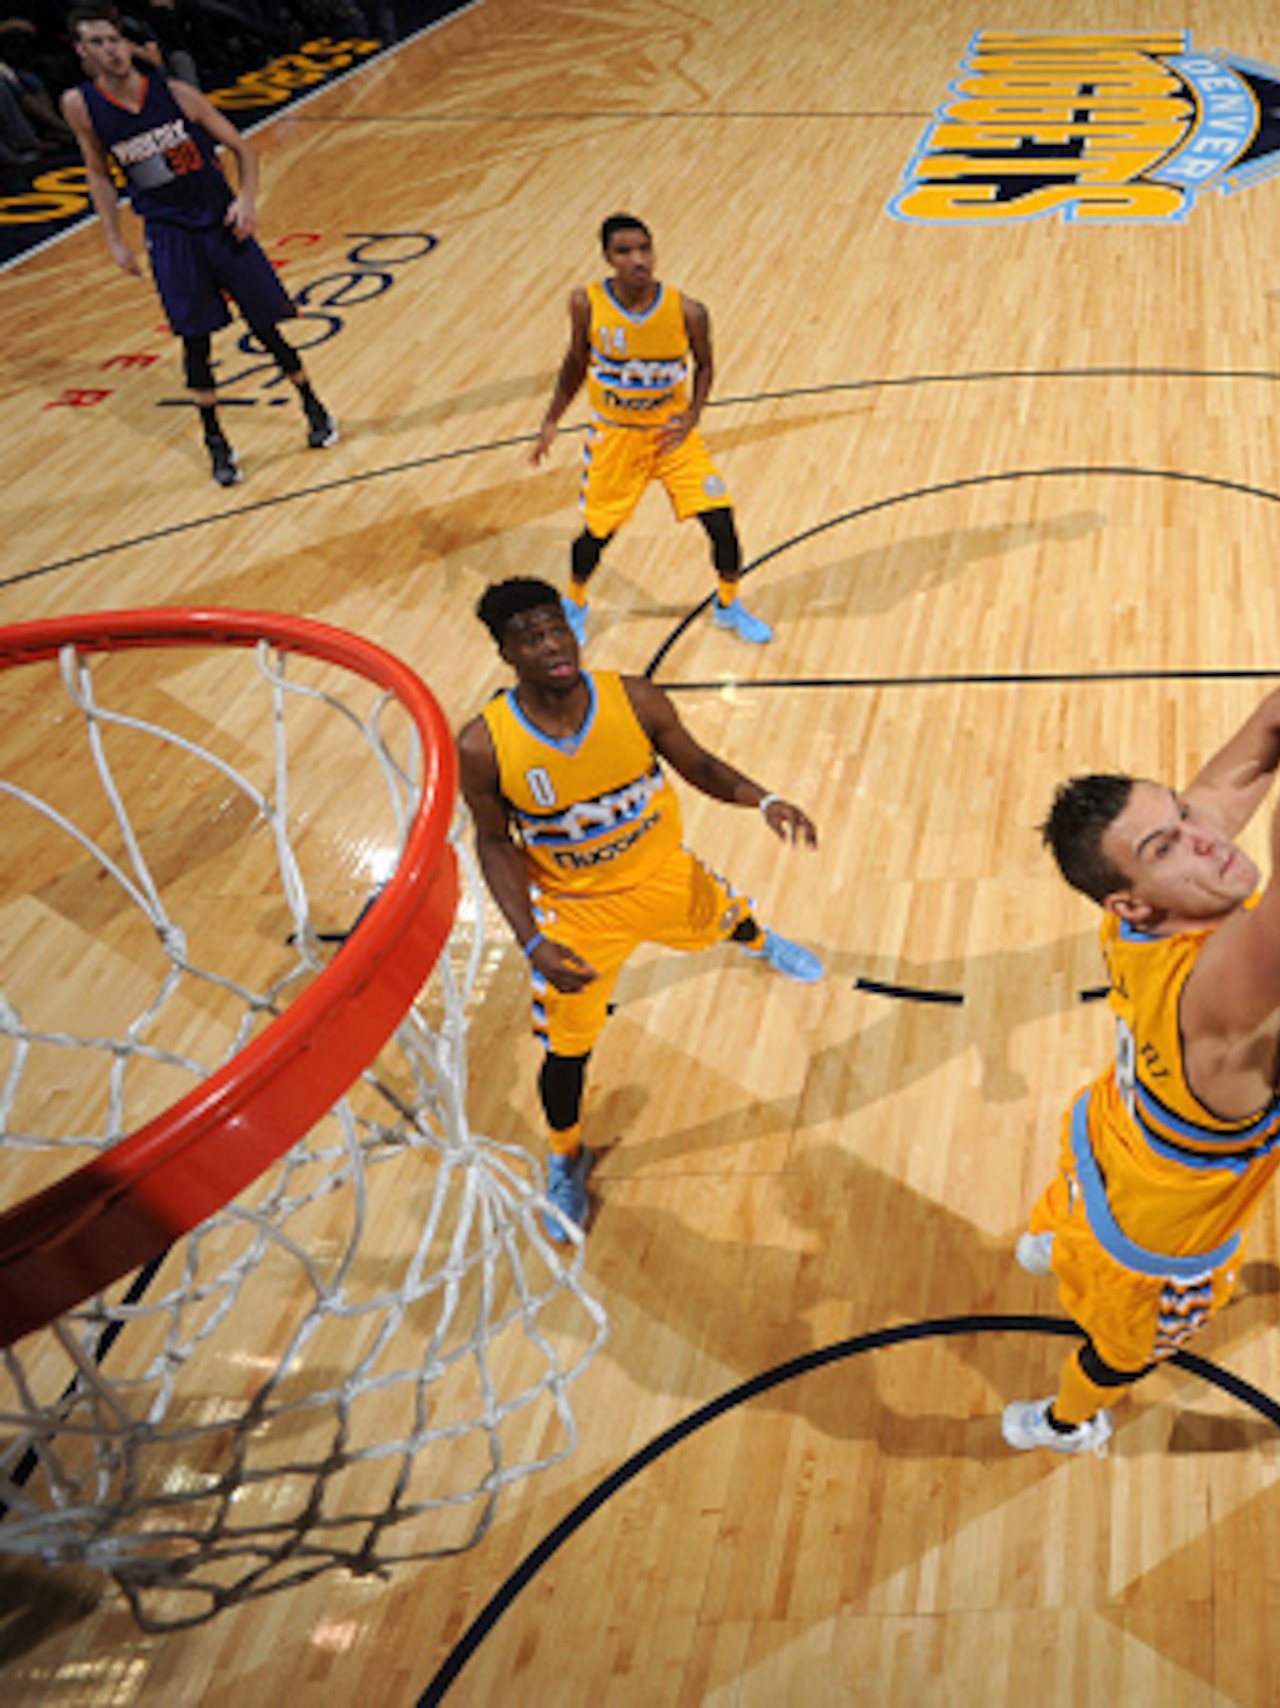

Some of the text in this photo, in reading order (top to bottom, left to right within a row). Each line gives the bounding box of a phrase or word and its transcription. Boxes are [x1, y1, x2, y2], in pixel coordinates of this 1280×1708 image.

[888, 29, 1192, 223] NUGGETS
[1165, 58, 1236, 180] DENVER
[526, 767, 556, 808] 0
